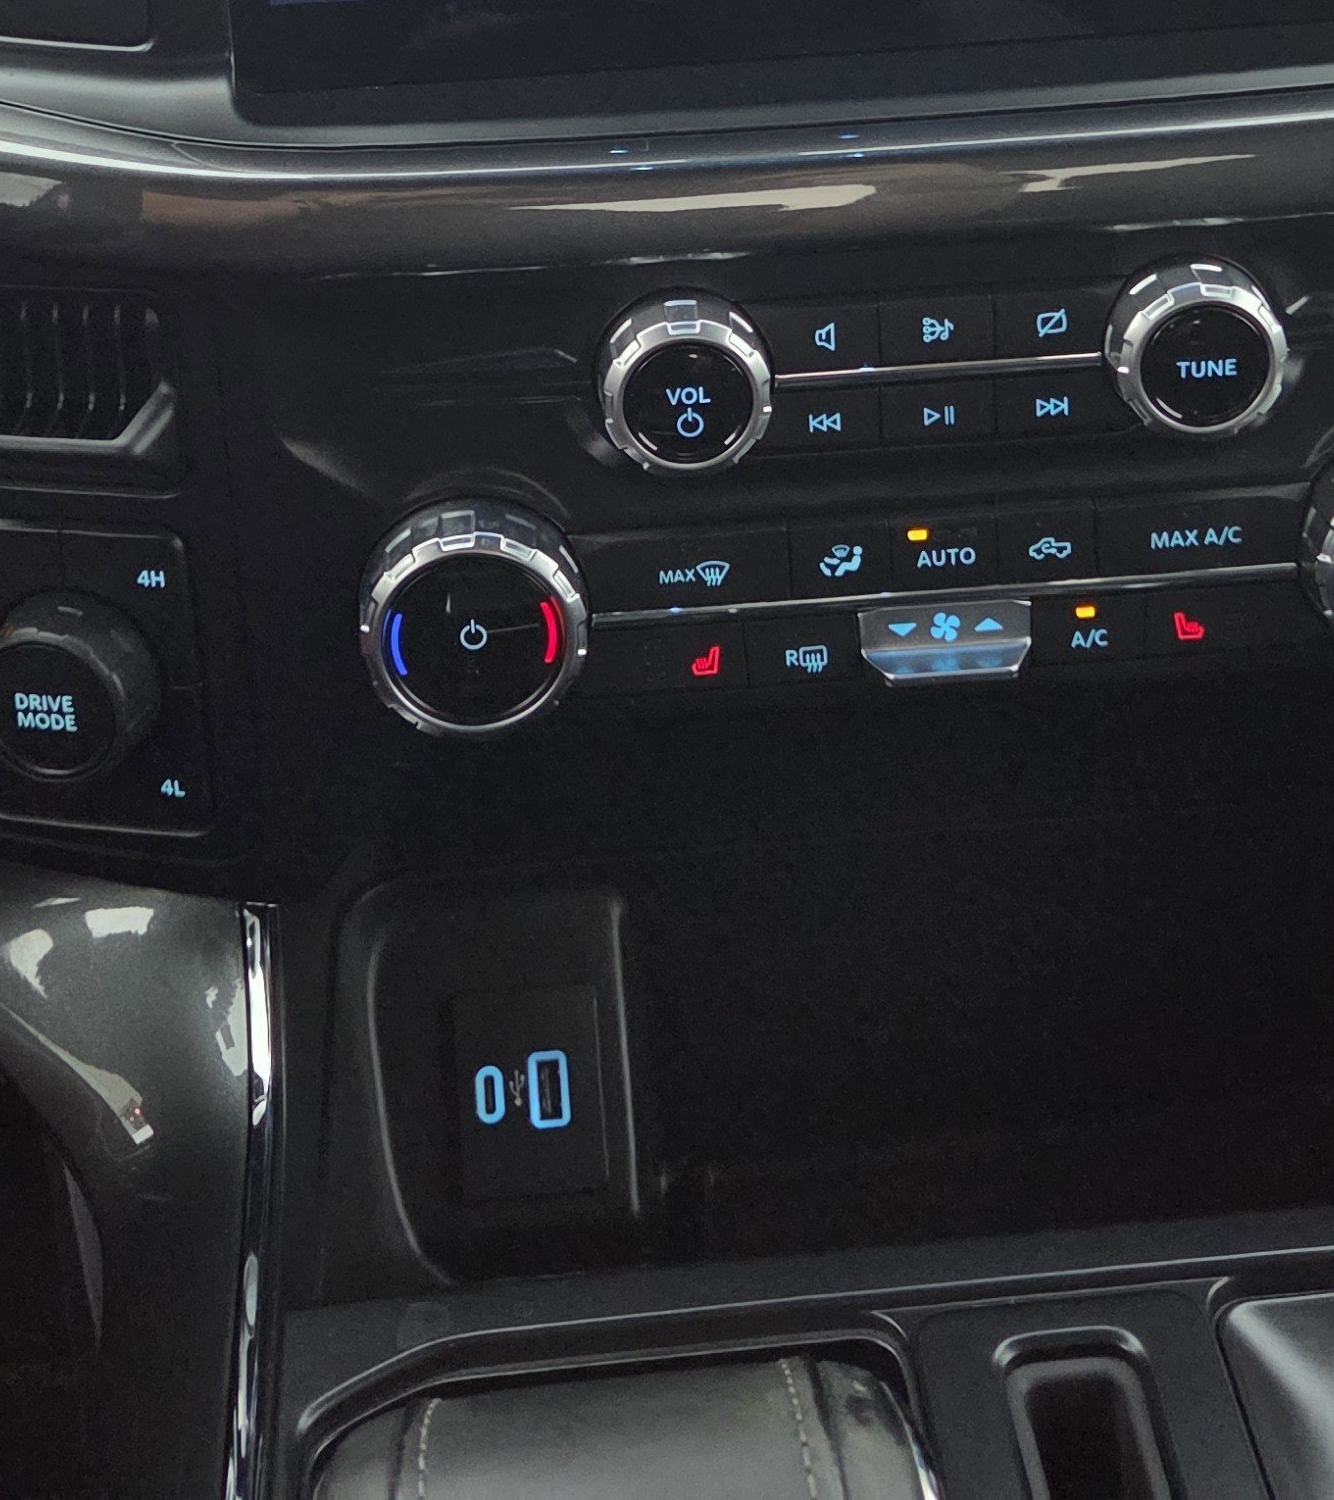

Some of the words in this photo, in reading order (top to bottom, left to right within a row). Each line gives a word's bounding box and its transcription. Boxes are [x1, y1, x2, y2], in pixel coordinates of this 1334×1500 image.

[1176, 358, 1238, 380] TUNE
[666, 386, 711, 406] VOL
[1150, 528, 1199, 549] MAX
[1203, 525, 1243, 547] A/C
[916, 546, 976, 569] AUTO
[137, 570, 165, 589] 4H
[659, 567, 696, 585] MAX
[1071, 629, 1108, 650] A/C
[14, 693, 75, 713] DRIVE
[17, 711, 78, 733] MODE
[160, 778, 186, 799] 4L
